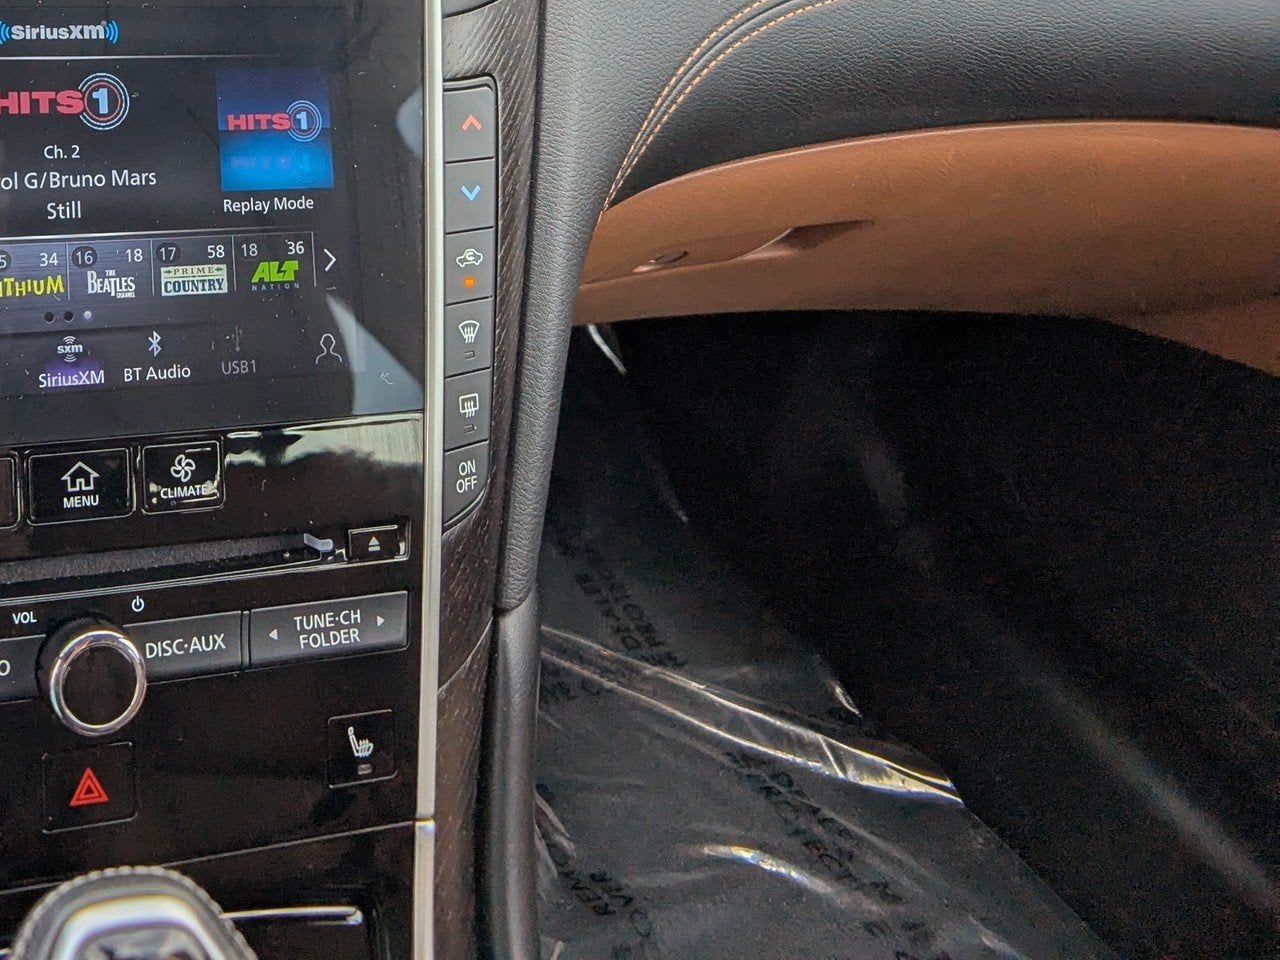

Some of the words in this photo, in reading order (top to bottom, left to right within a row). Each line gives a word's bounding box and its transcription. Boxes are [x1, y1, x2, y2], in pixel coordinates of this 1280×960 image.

[43, 144, 68, 159] Ch.
[71, 144, 80, 159] 2
[24, 171, 106, 189] G/Bruno
[111, 169, 157, 187] Mars
[46, 200, 82, 220] Still
[223, 197, 271, 215] Replay
[274, 195, 314, 211] Mode
[125, 248, 143, 263] 18
[159, 246, 176, 261] 17
[207, 244, 225, 259] 58
[241, 243, 258, 257] 18
[287, 240, 304, 255] 36
[39, 252, 59, 267] 34
[75, 249, 93, 265] 16
[105, 269, 116, 277] THE
[173, 266, 216, 276] PRIME
[251, 260, 299, 284] ALT
[86, 270, 136, 297] BEATLES
[163, 278, 225, 295] COUNTRY
[252, 282, 300, 291] NATION
[123, 367, 142, 382] BT
[144, 364, 191, 381] Audio
[221, 359, 257, 375] USB1
[38, 370, 105, 388] SiriusXM
[458, 459, 476, 476] ON
[456, 474, 478, 493] OFF
[160, 484, 209, 500] CLIMATE
[63, 494, 100, 509] MENU
[12, 611, 38, 625] VOL
[299, 628, 361, 650] FOLDER
